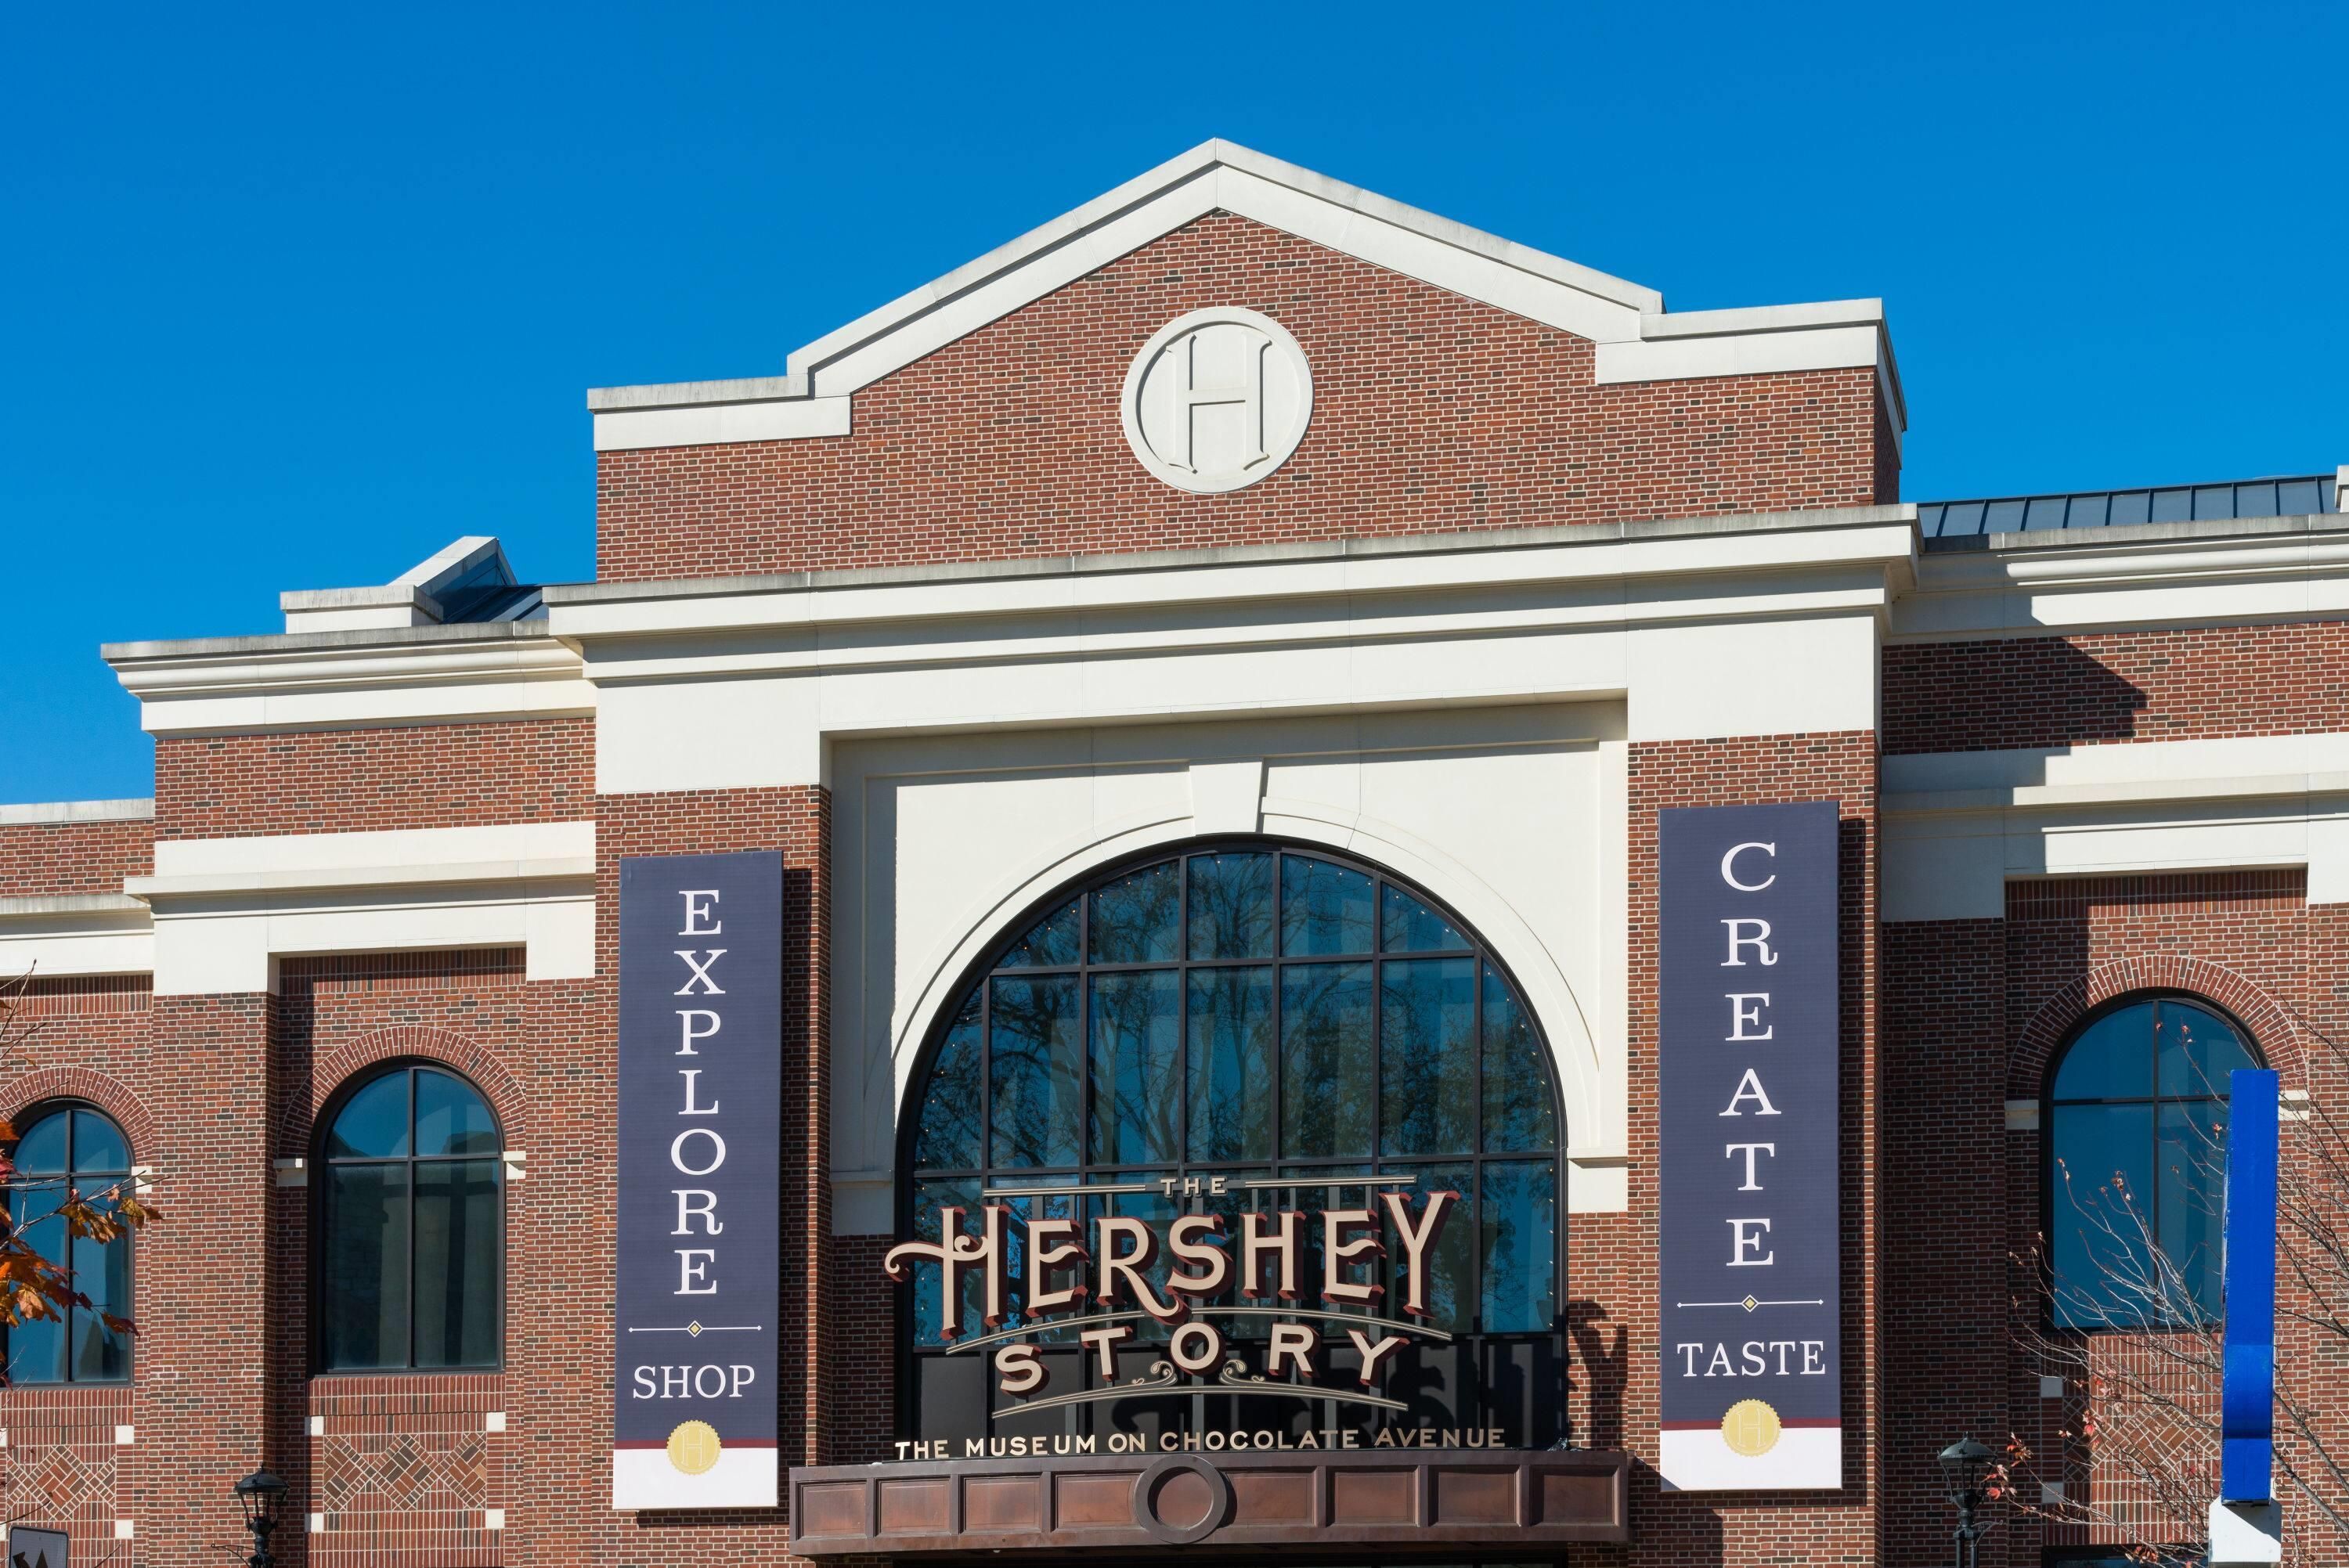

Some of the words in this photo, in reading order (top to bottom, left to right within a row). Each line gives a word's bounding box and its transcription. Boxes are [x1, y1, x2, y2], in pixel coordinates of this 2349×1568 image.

[1165, 326, 1273, 474] H
[1719, 842, 1781, 1267] CREATE
[670, 889, 727, 1295] EXPLORE
[1160, 1177, 1225, 1195] THE
[885, 1191, 1460, 1339] HERSHEY
[994, 1321, 1409, 1396] STORY
[1676, 1340, 1826, 1377] TASTE
[633, 1364, 755, 1399] SHOP
[680, 1428, 709, 1467] H
[895, 1440, 949, 1460] THE
[965, 1434, 1095, 1457] MUSEUM
[1108, 1433, 1146, 1452] ON
[1160, 1429, 1360, 1451] CHOCOLATE
[1374, 1427, 1506, 1448] AVENUE
[1733, 1408, 1767, 1448] H
